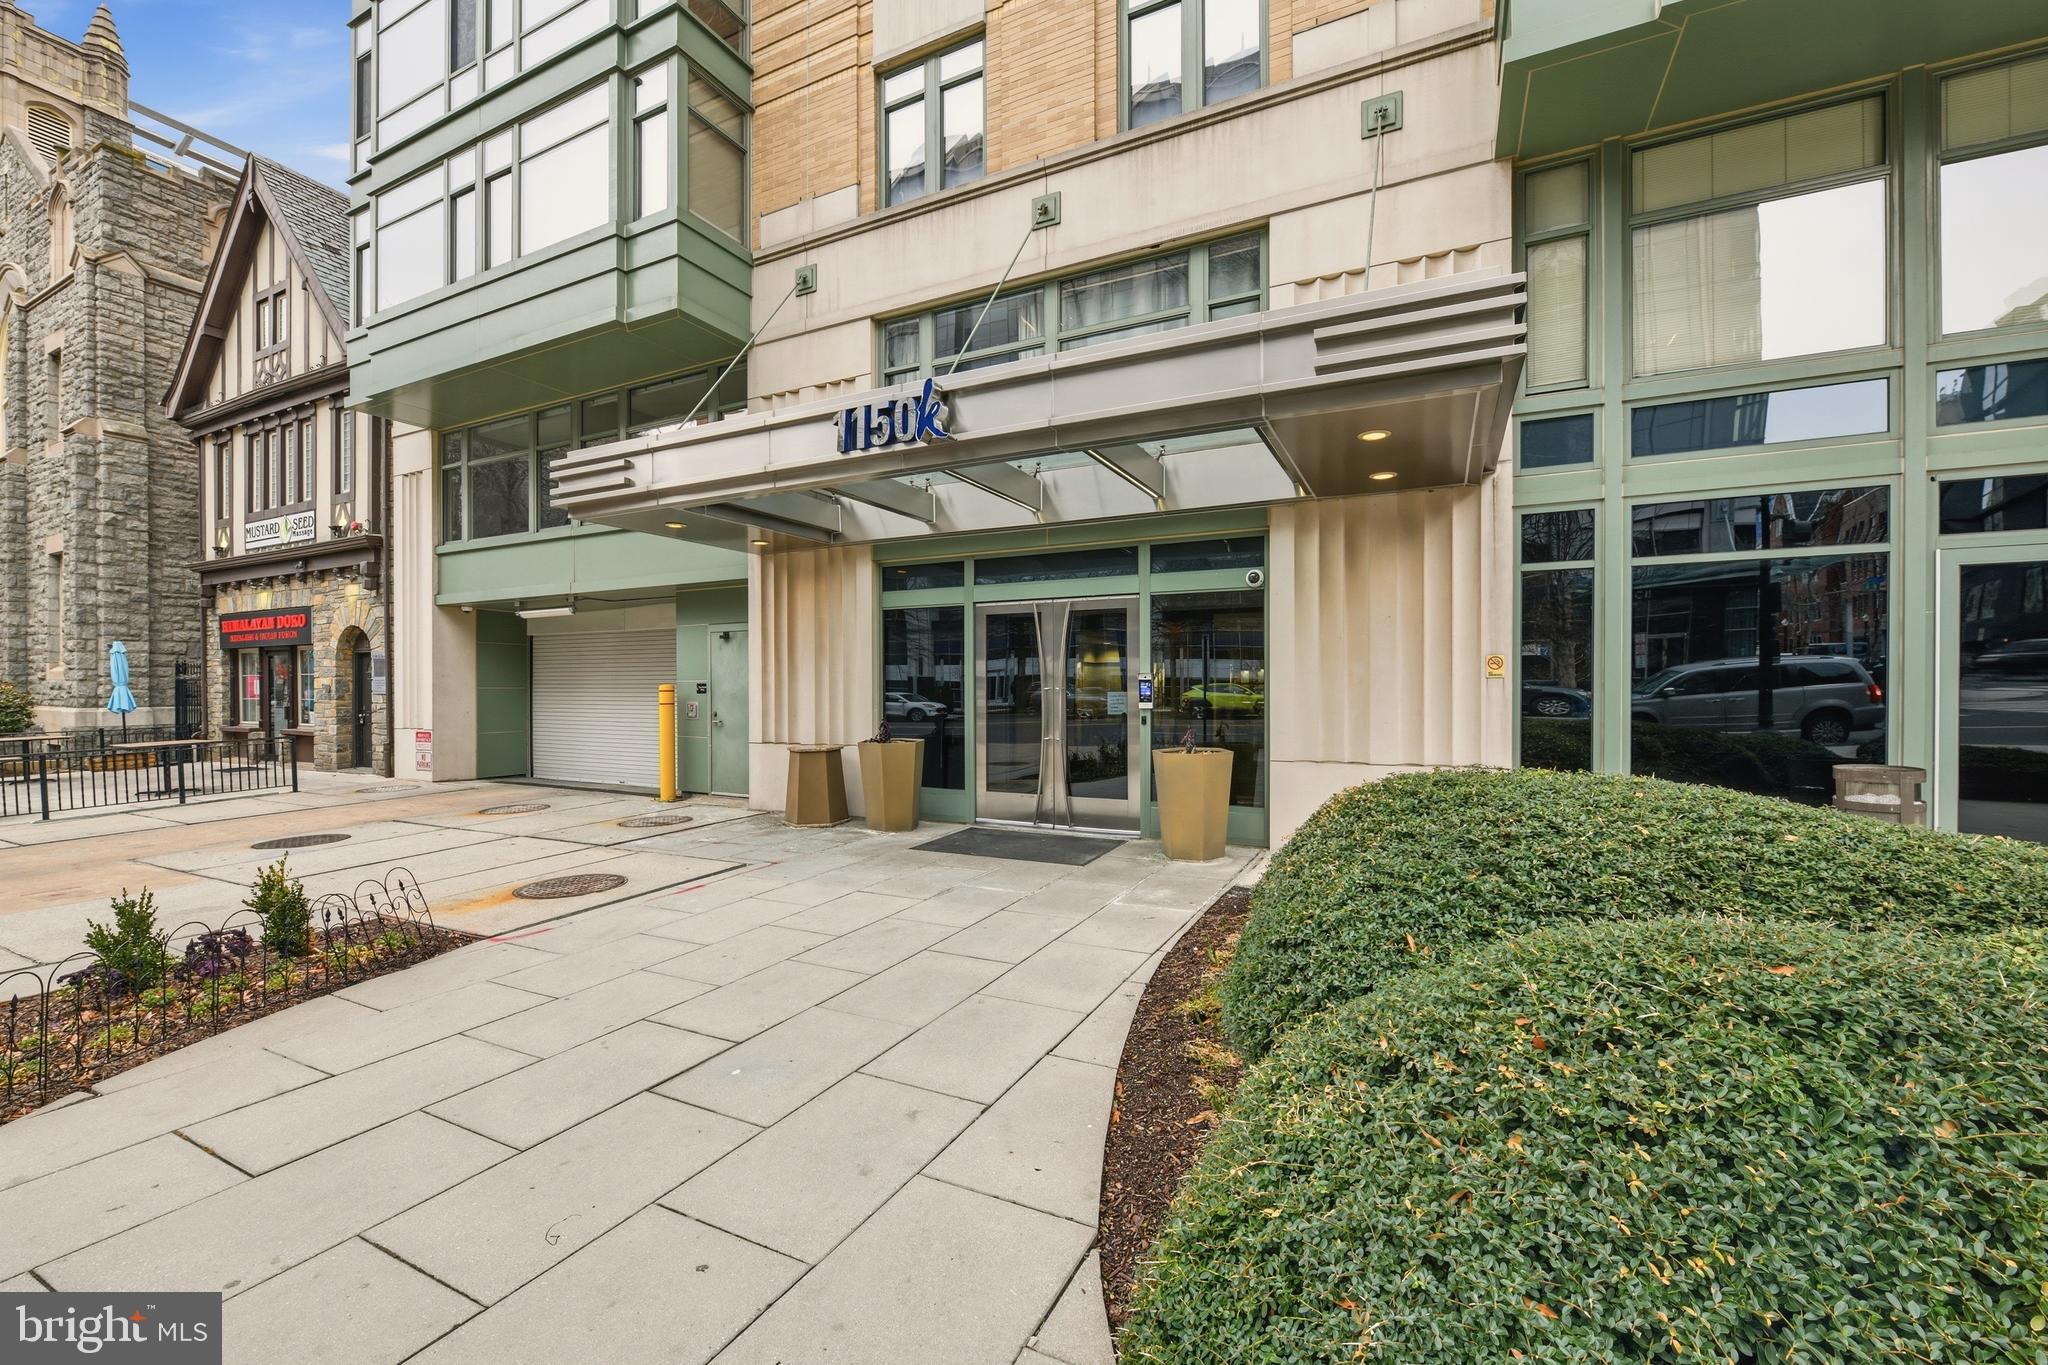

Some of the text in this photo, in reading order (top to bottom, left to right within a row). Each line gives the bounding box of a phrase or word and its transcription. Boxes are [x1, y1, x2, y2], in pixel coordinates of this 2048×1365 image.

[833, 378, 952, 453] 1150k
[246, 516, 314, 538] MUSTARD SEED
[221, 613, 306, 633] HIMALAYAN DOKO
